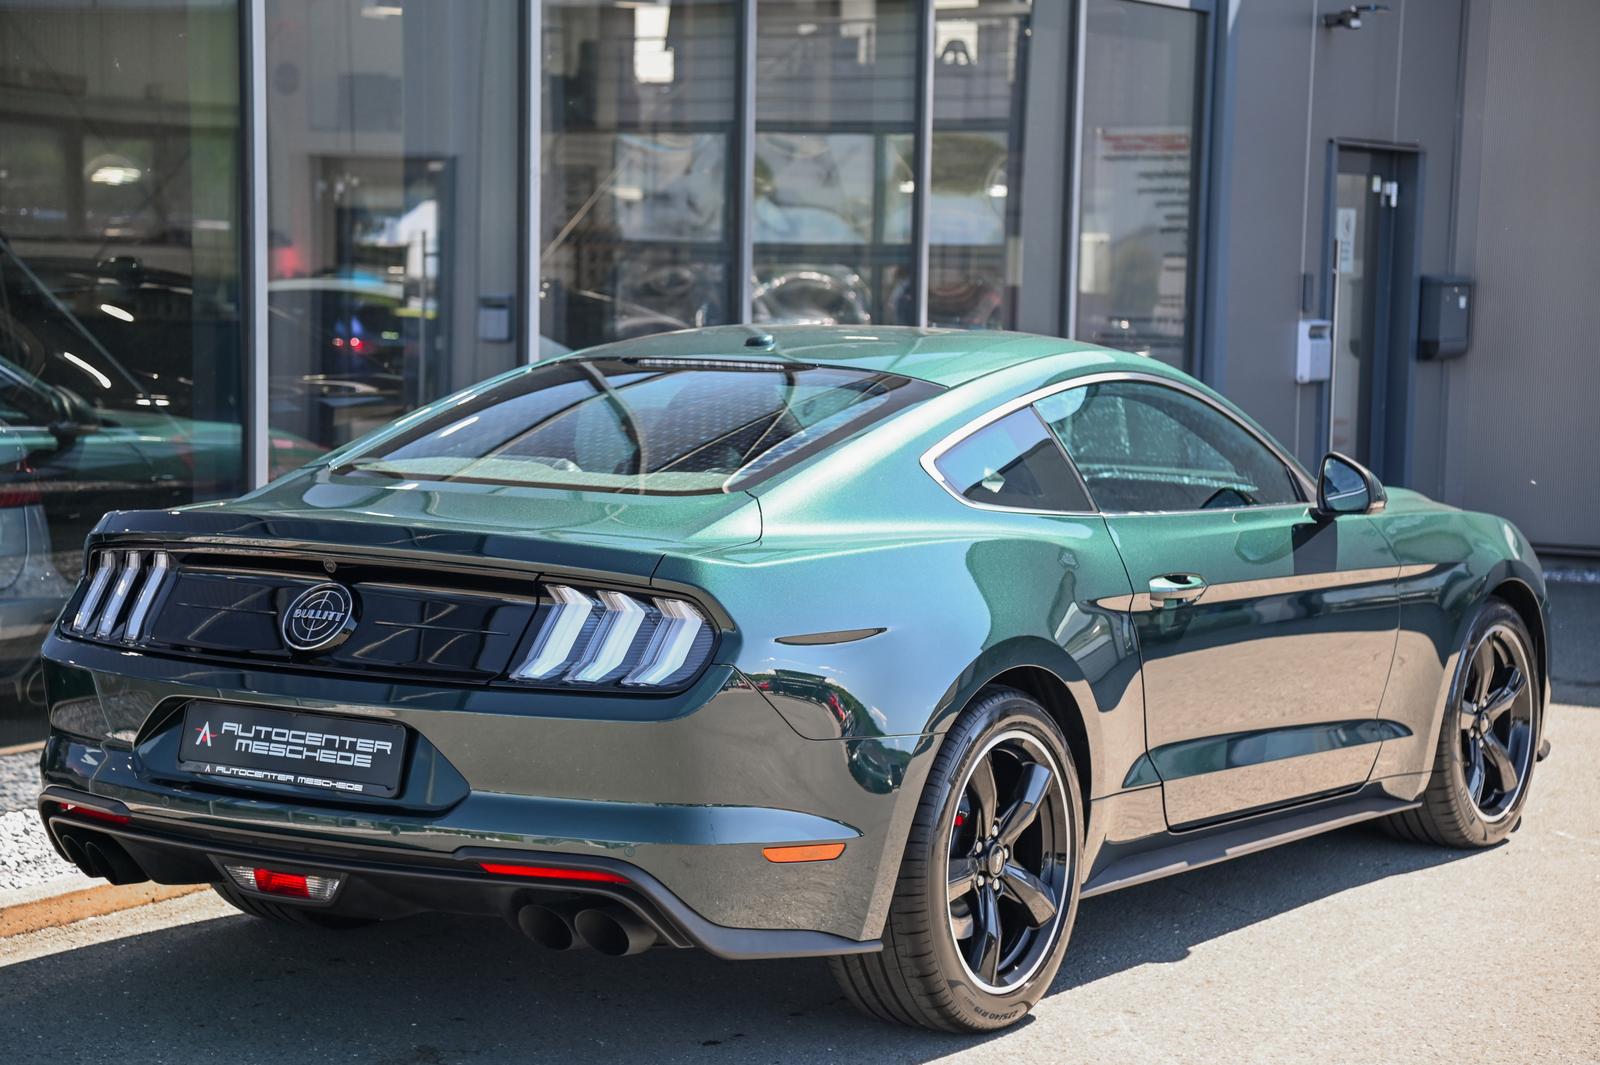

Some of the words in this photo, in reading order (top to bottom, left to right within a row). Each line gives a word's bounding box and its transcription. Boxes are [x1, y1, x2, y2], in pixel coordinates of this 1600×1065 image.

[292, 608, 345, 622] BULLITT
[221, 721, 393, 755] AUTOCENTER
[235, 739, 373, 768] MESCHEDE
[215, 765, 295, 783] AUTOCENTER
[297, 775, 363, 792] MESCHEDE
